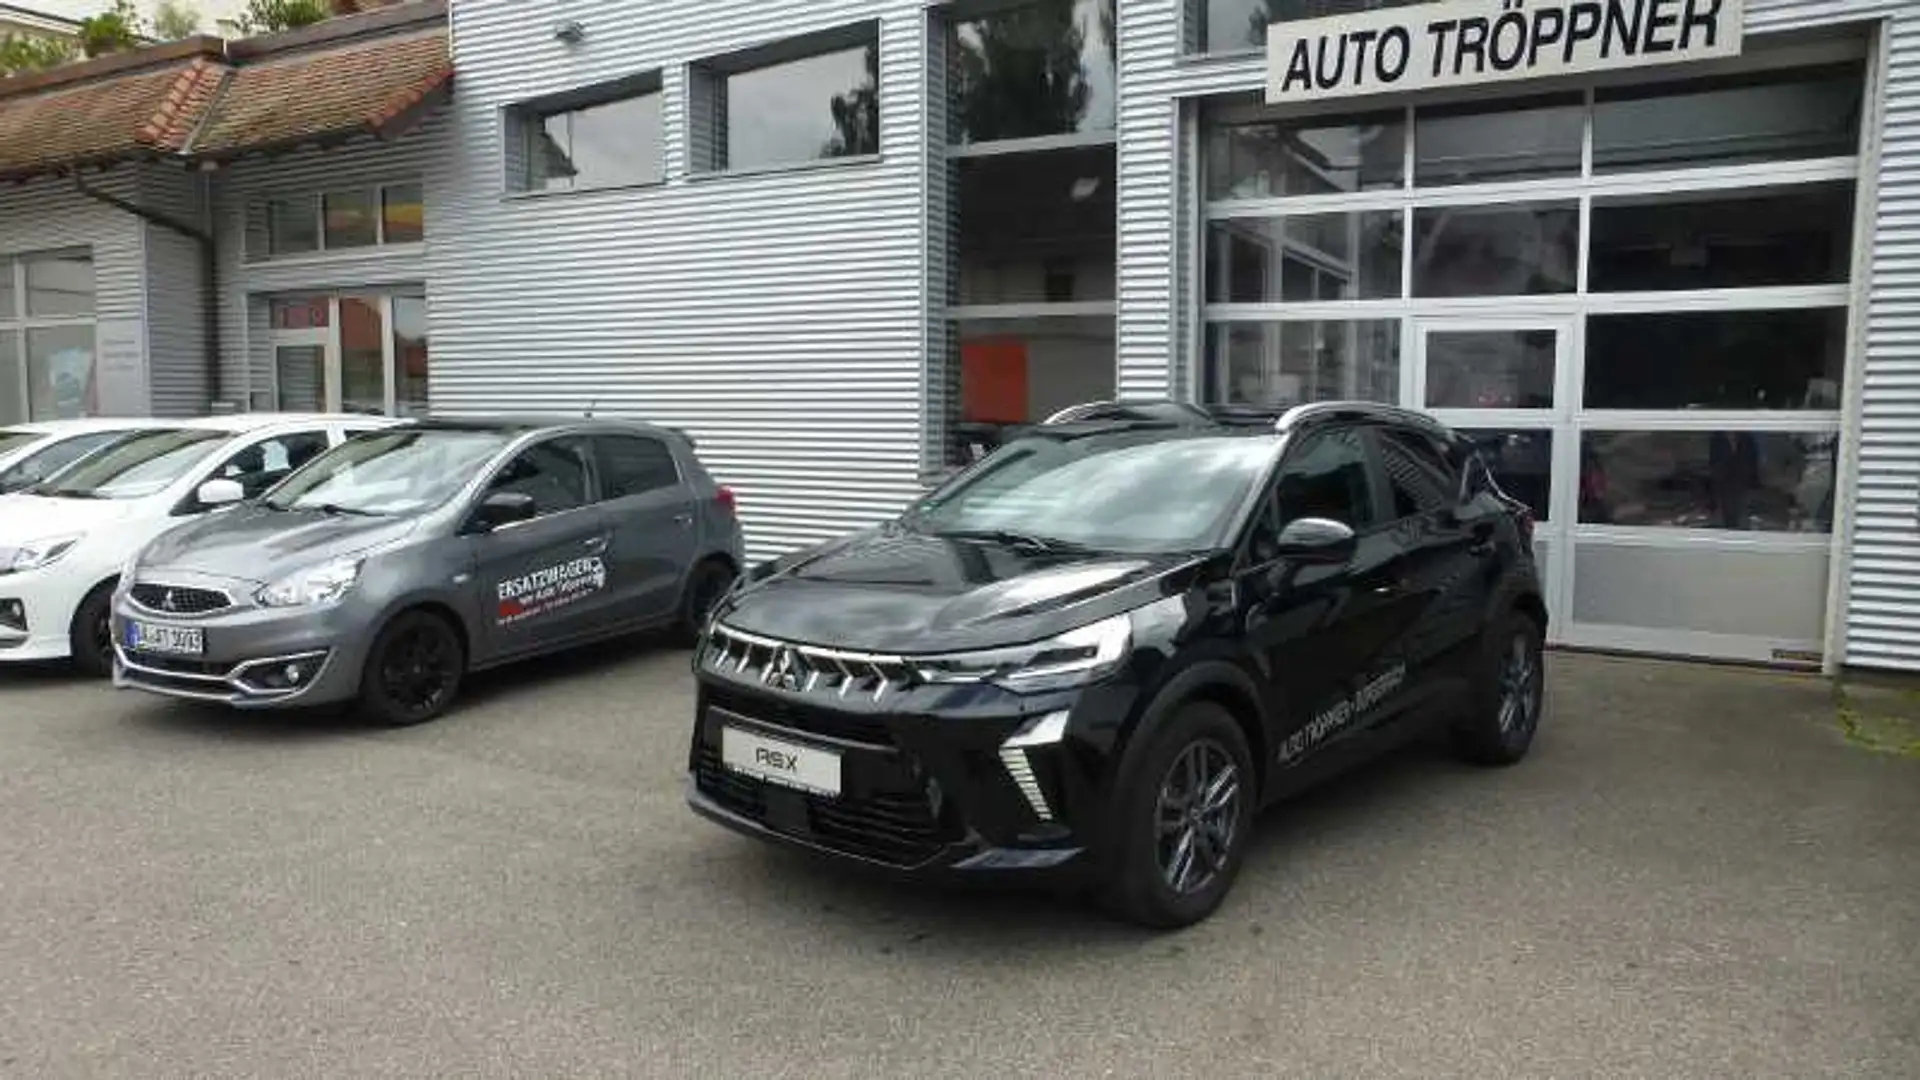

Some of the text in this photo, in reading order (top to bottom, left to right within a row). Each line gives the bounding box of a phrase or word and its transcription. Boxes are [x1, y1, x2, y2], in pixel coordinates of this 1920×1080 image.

[1282, 0, 1723, 92] AUTO TRÖPPNER
[498, 559, 591, 600] ERSATZWAGEN
